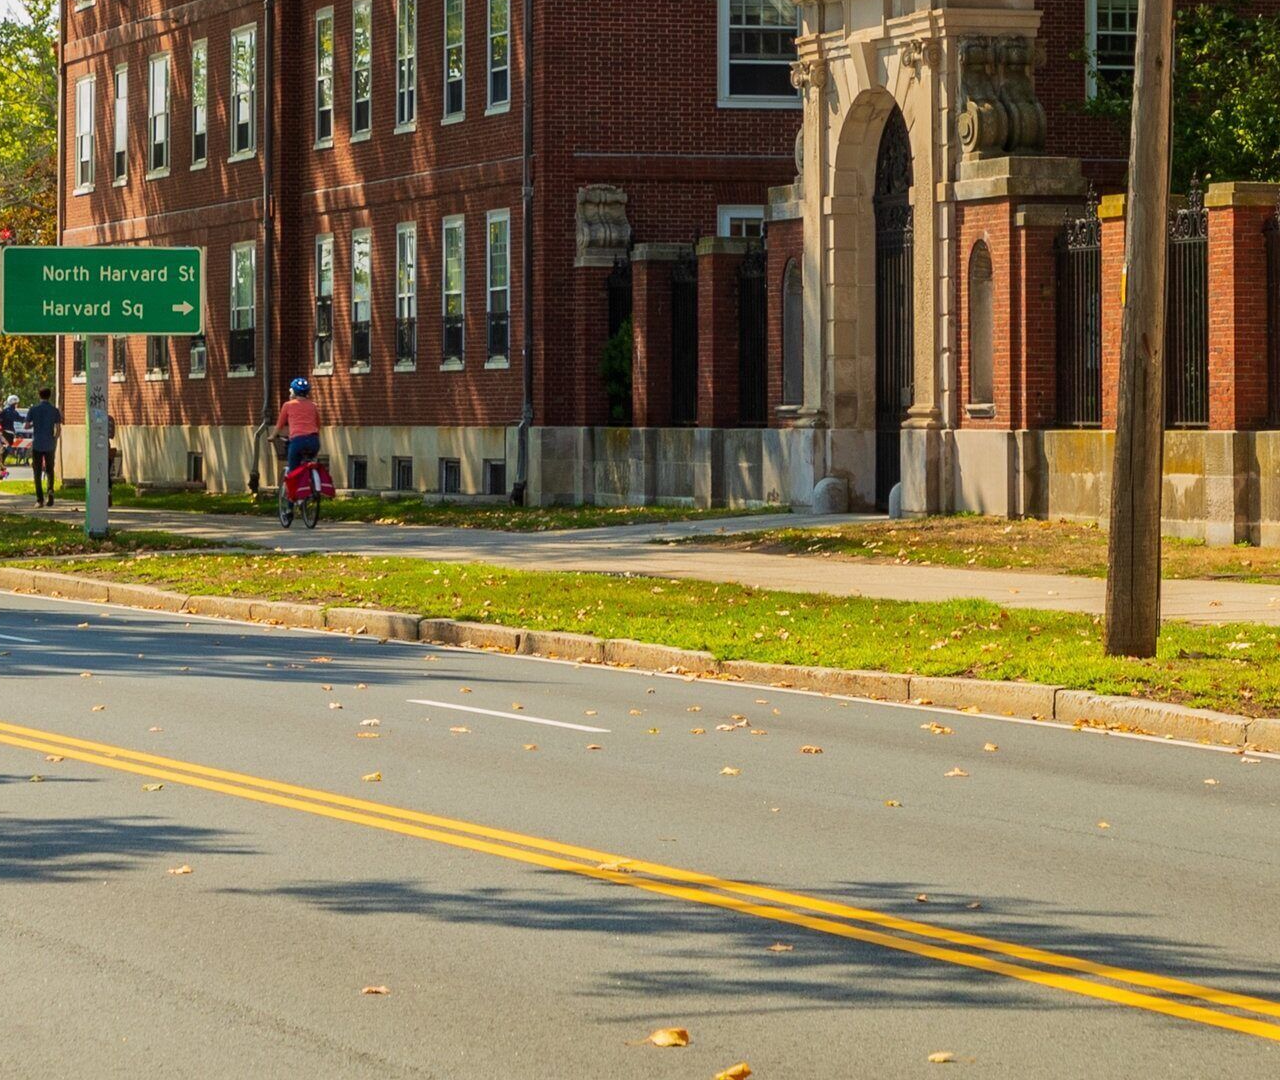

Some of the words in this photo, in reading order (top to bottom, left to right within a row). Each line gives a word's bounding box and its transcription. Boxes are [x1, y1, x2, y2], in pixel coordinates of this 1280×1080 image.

[42, 265, 90, 282] North
[99, 265, 168, 282] Harvard
[178, 265, 195, 282] St
[42, 299, 111, 316] Harvard
[121, 299, 144, 320] Sq
